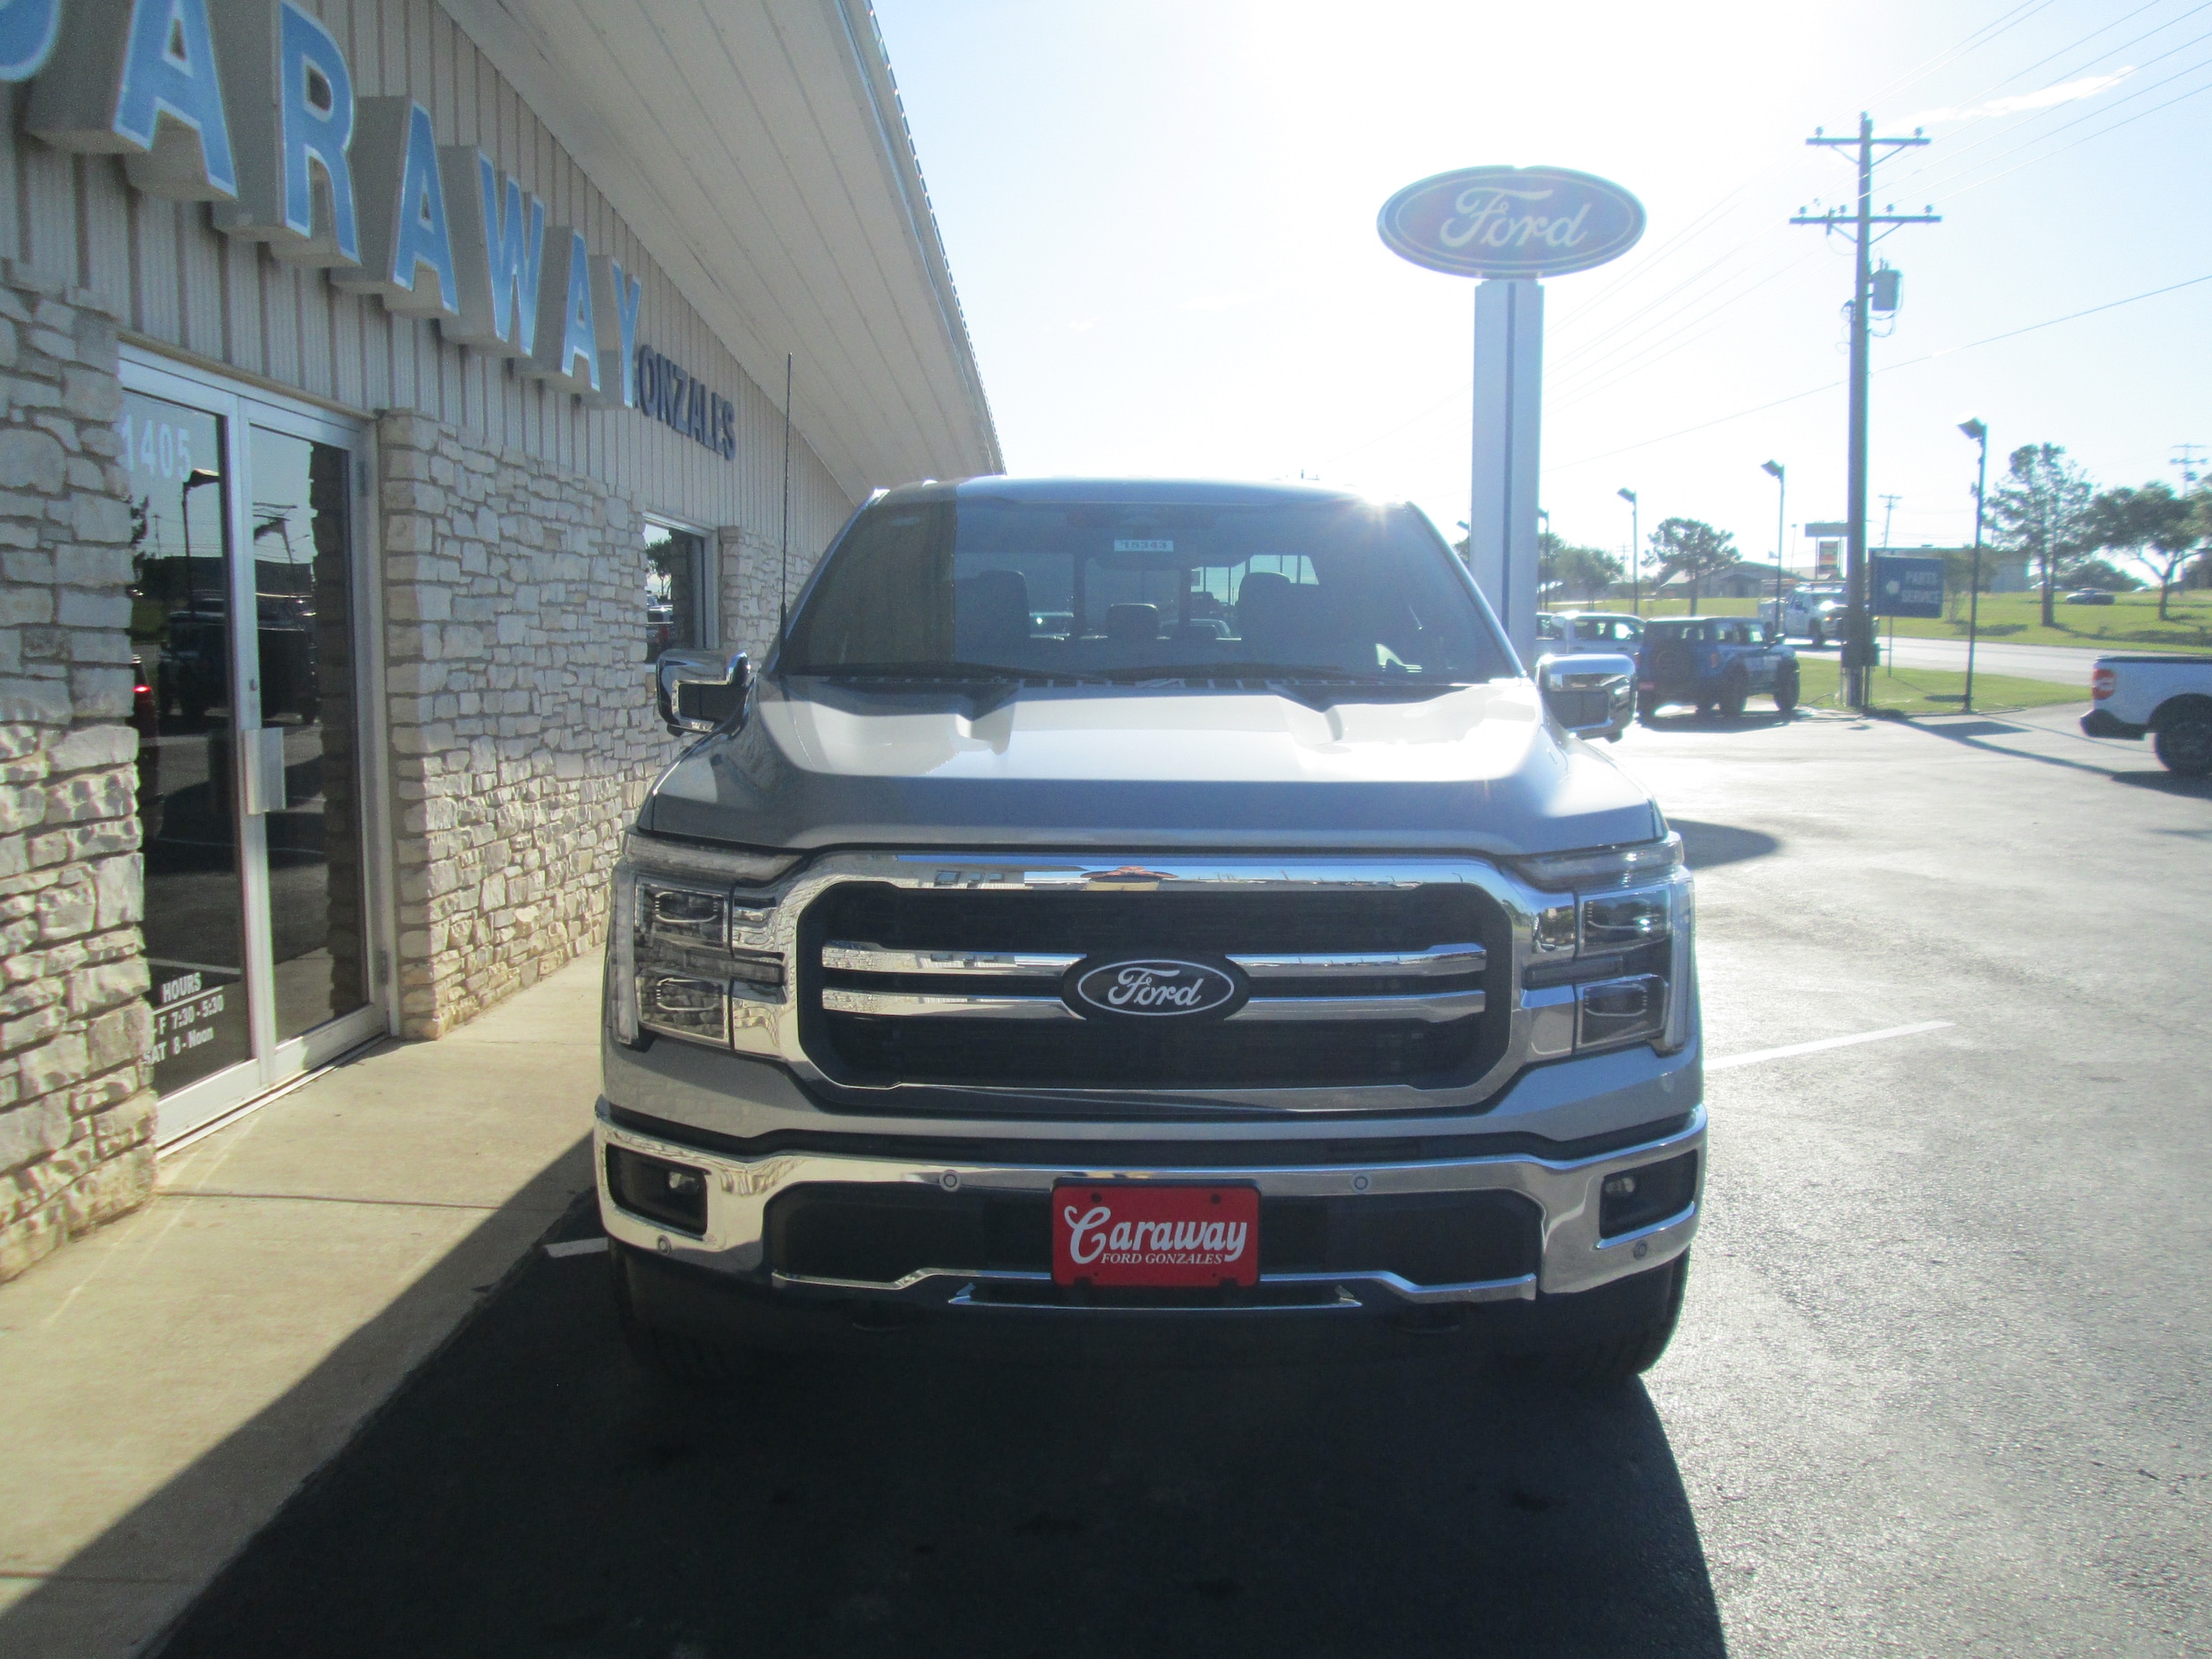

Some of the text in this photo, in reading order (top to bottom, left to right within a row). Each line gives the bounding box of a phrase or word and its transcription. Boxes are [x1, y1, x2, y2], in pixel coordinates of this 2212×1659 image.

[0, 0, 642, 409] ARAWAY
[1440, 187, 1592, 248] Ford
[634, 343, 736, 461] ONZALES
[120, 413, 191, 482] 1405
[162, 972, 202, 1003] HOURS
[1108, 967, 1204, 1006] Ford
[173, 1036, 180, 1055] 8
[188, 1026, 214, 1048] Noon
[1064, 1205, 1248, 1264] Caraway
[1101, 1253, 1223, 1265] FORD GONZALES
